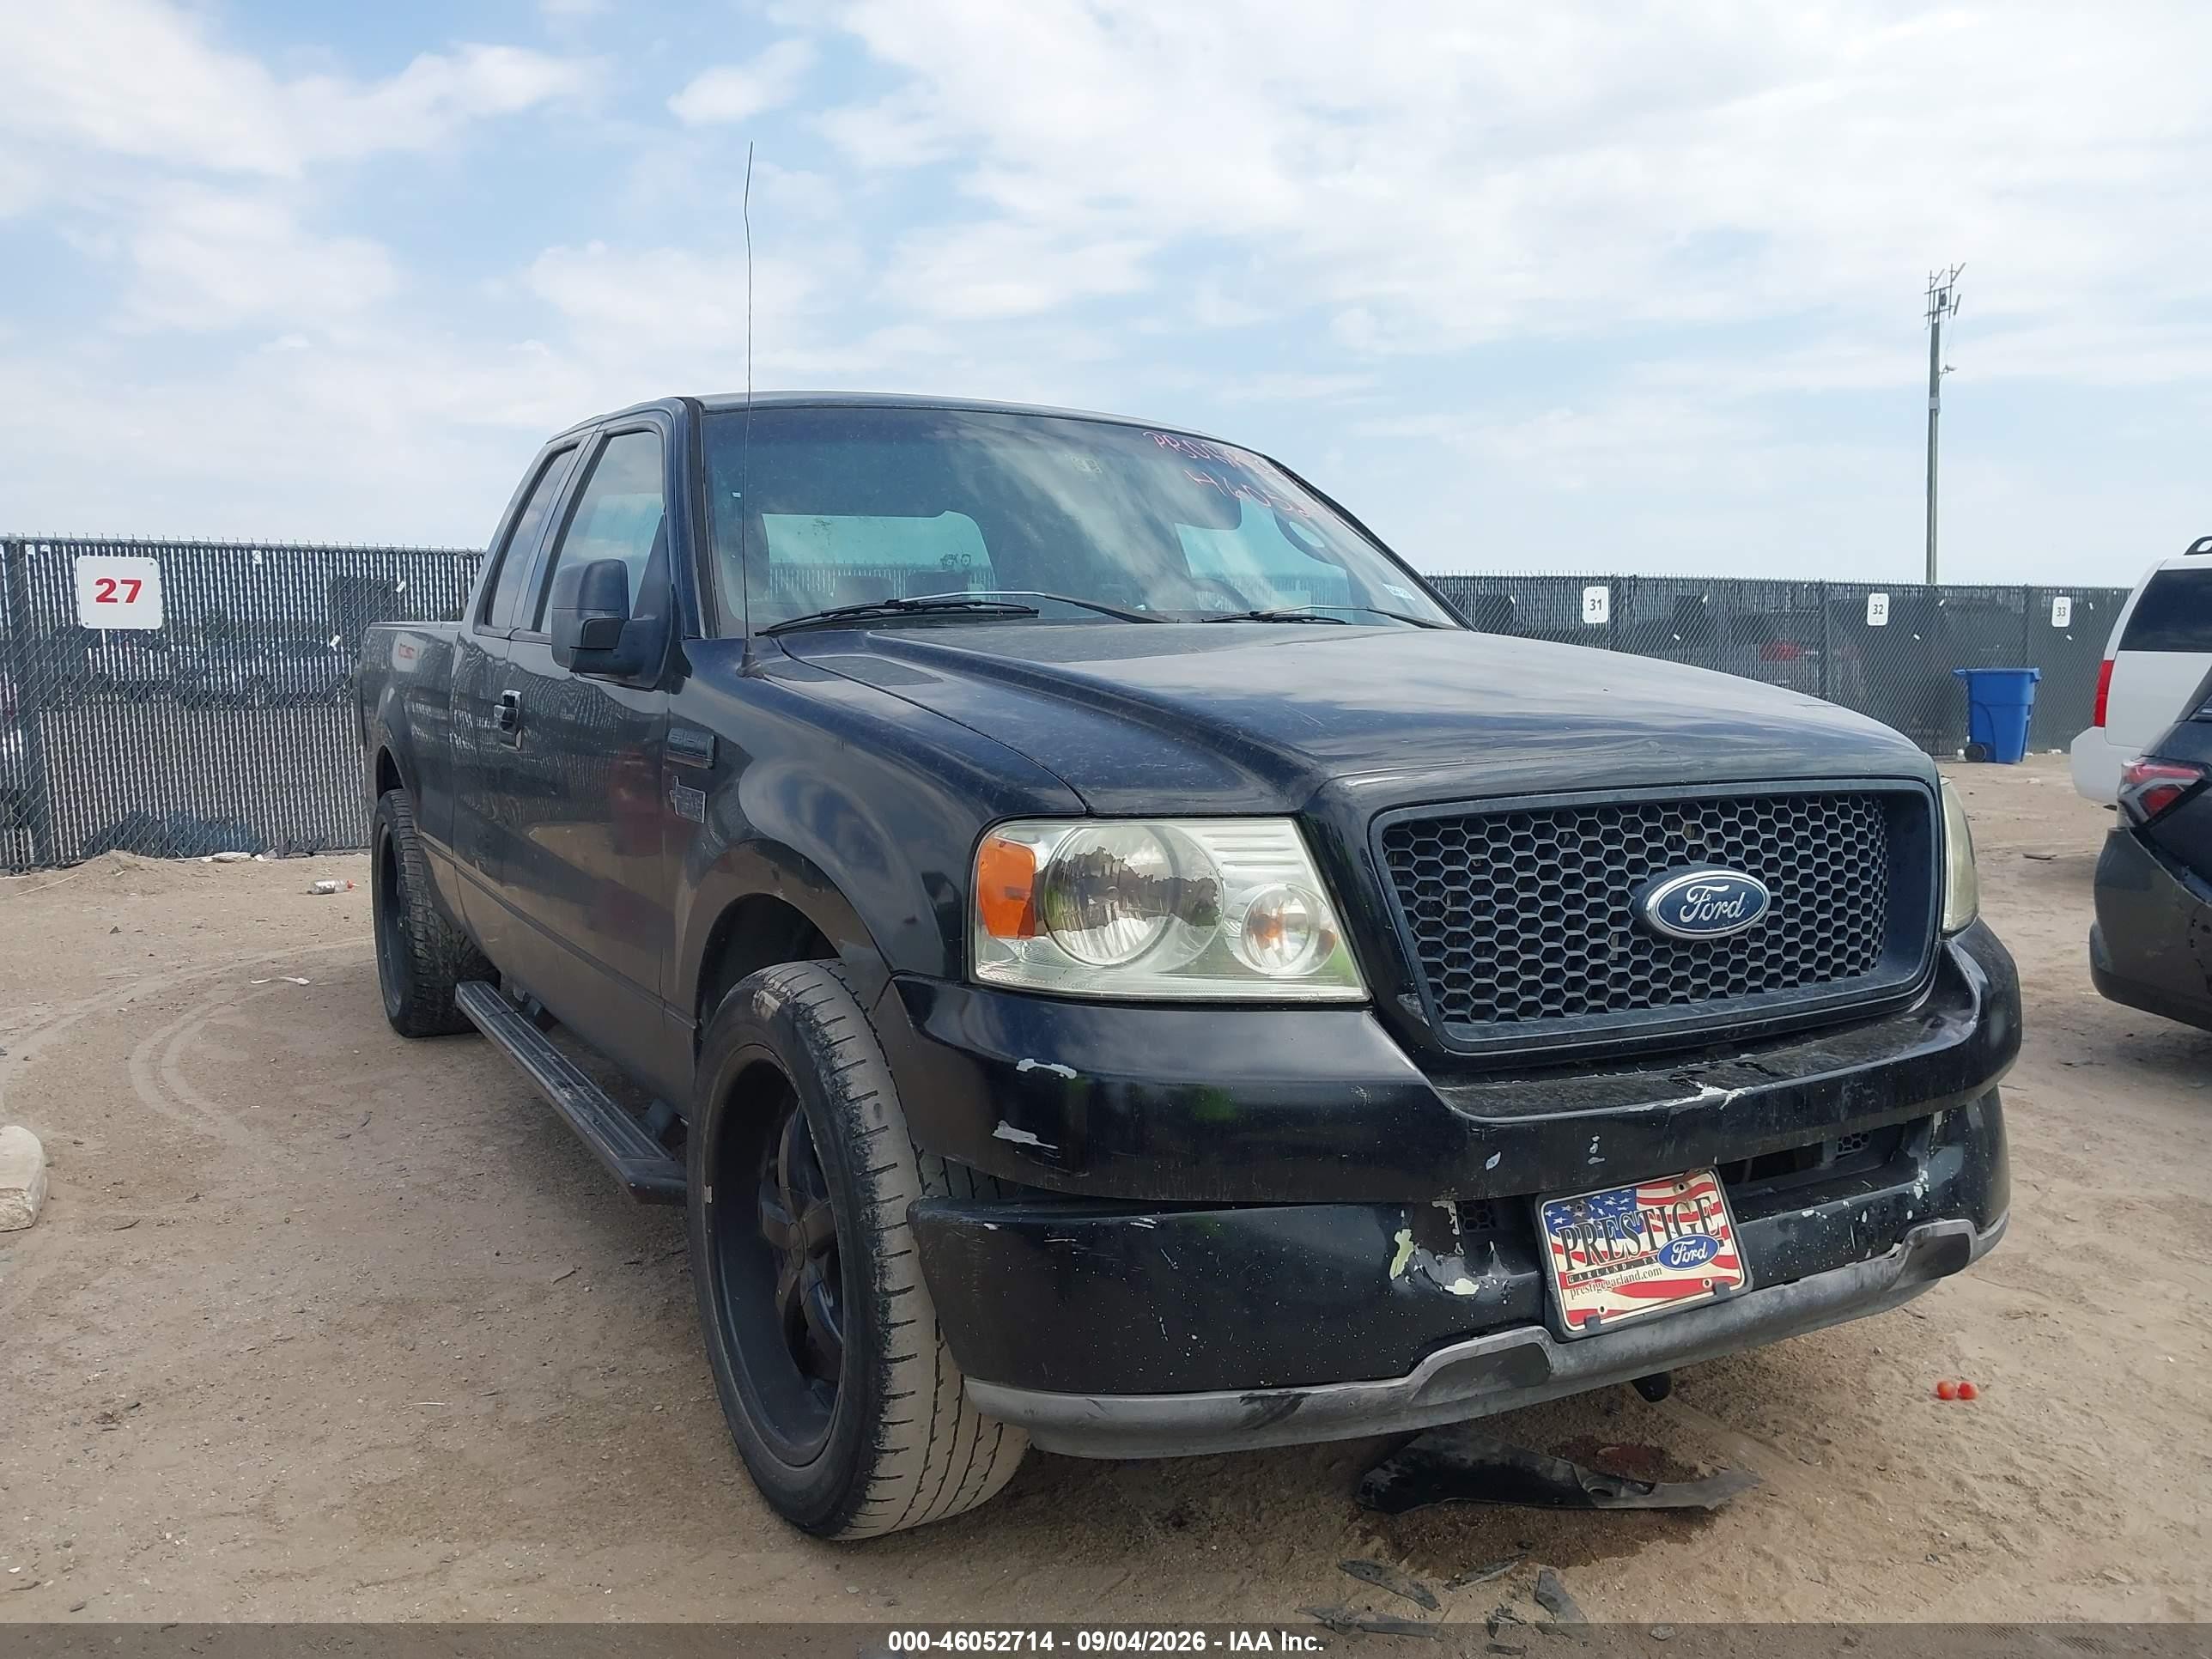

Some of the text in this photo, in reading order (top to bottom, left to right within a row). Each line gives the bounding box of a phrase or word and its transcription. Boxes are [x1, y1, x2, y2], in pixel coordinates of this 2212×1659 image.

[94, 578, 143, 604] 27
[1589, 599, 1602, 611] 31
[1872, 604, 1884, 615] 32
[2056, 606, 2066, 617] 33
[1679, 884, 1746, 923] Ford
[1556, 1195, 1720, 1272] PRESTIGE
[1642, 1255, 1657, 1266] TX
[1671, 1239, 1708, 1266] Ford
[1570, 1267, 1662, 1300] prestigegarland.com
